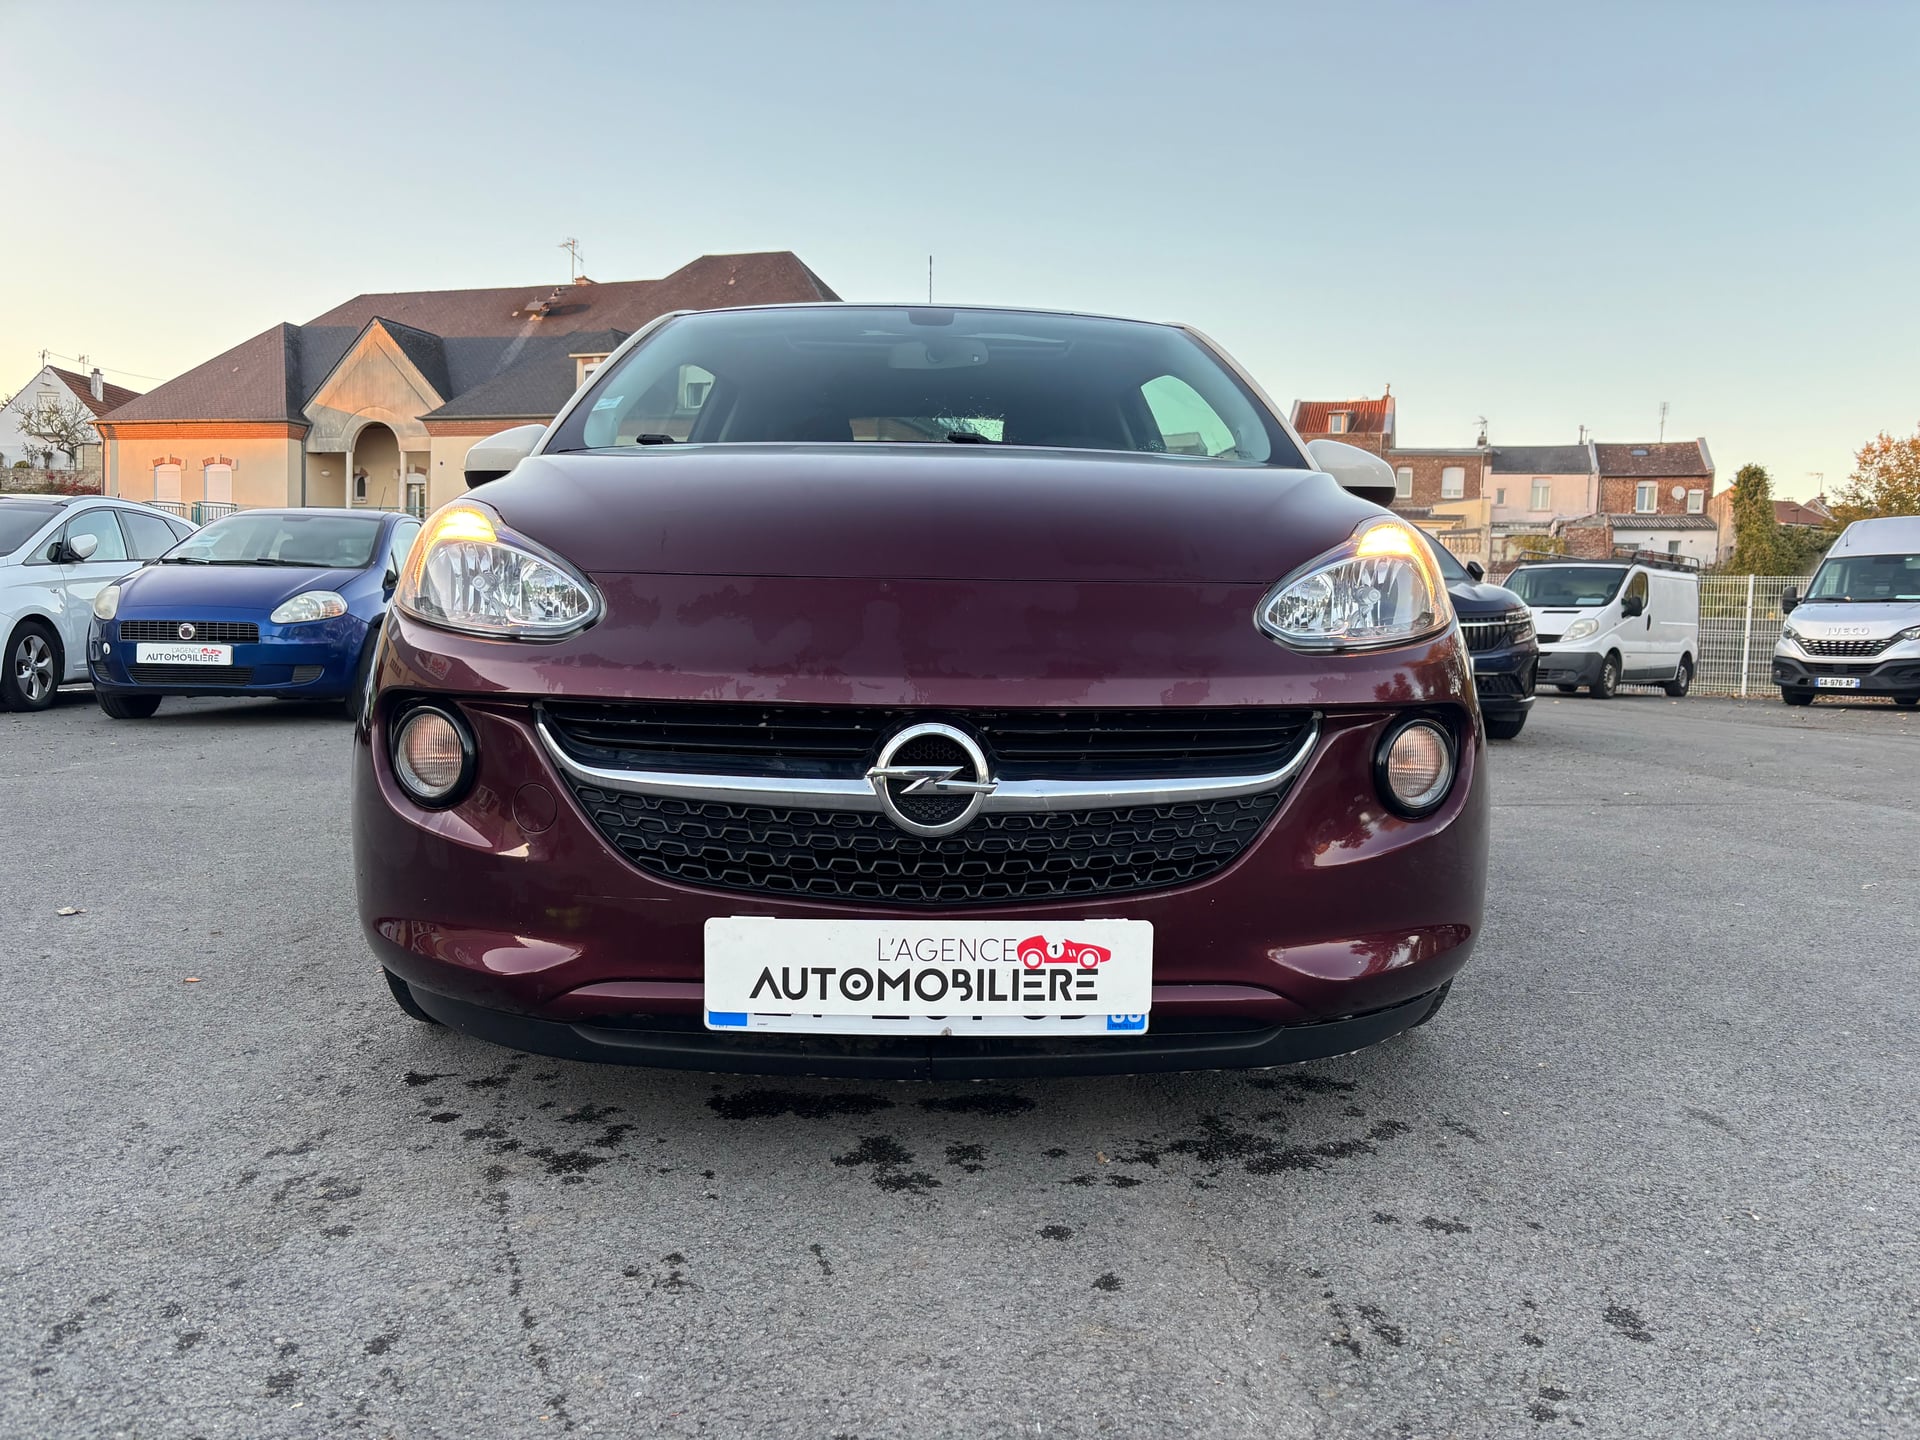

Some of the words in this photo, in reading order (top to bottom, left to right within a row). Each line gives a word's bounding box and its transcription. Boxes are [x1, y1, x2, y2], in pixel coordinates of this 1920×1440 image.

[1826, 627, 1870, 636] IVECO
[877, 937, 1017, 962] L'AGENCE
[1051, 943, 1058, 955] 1
